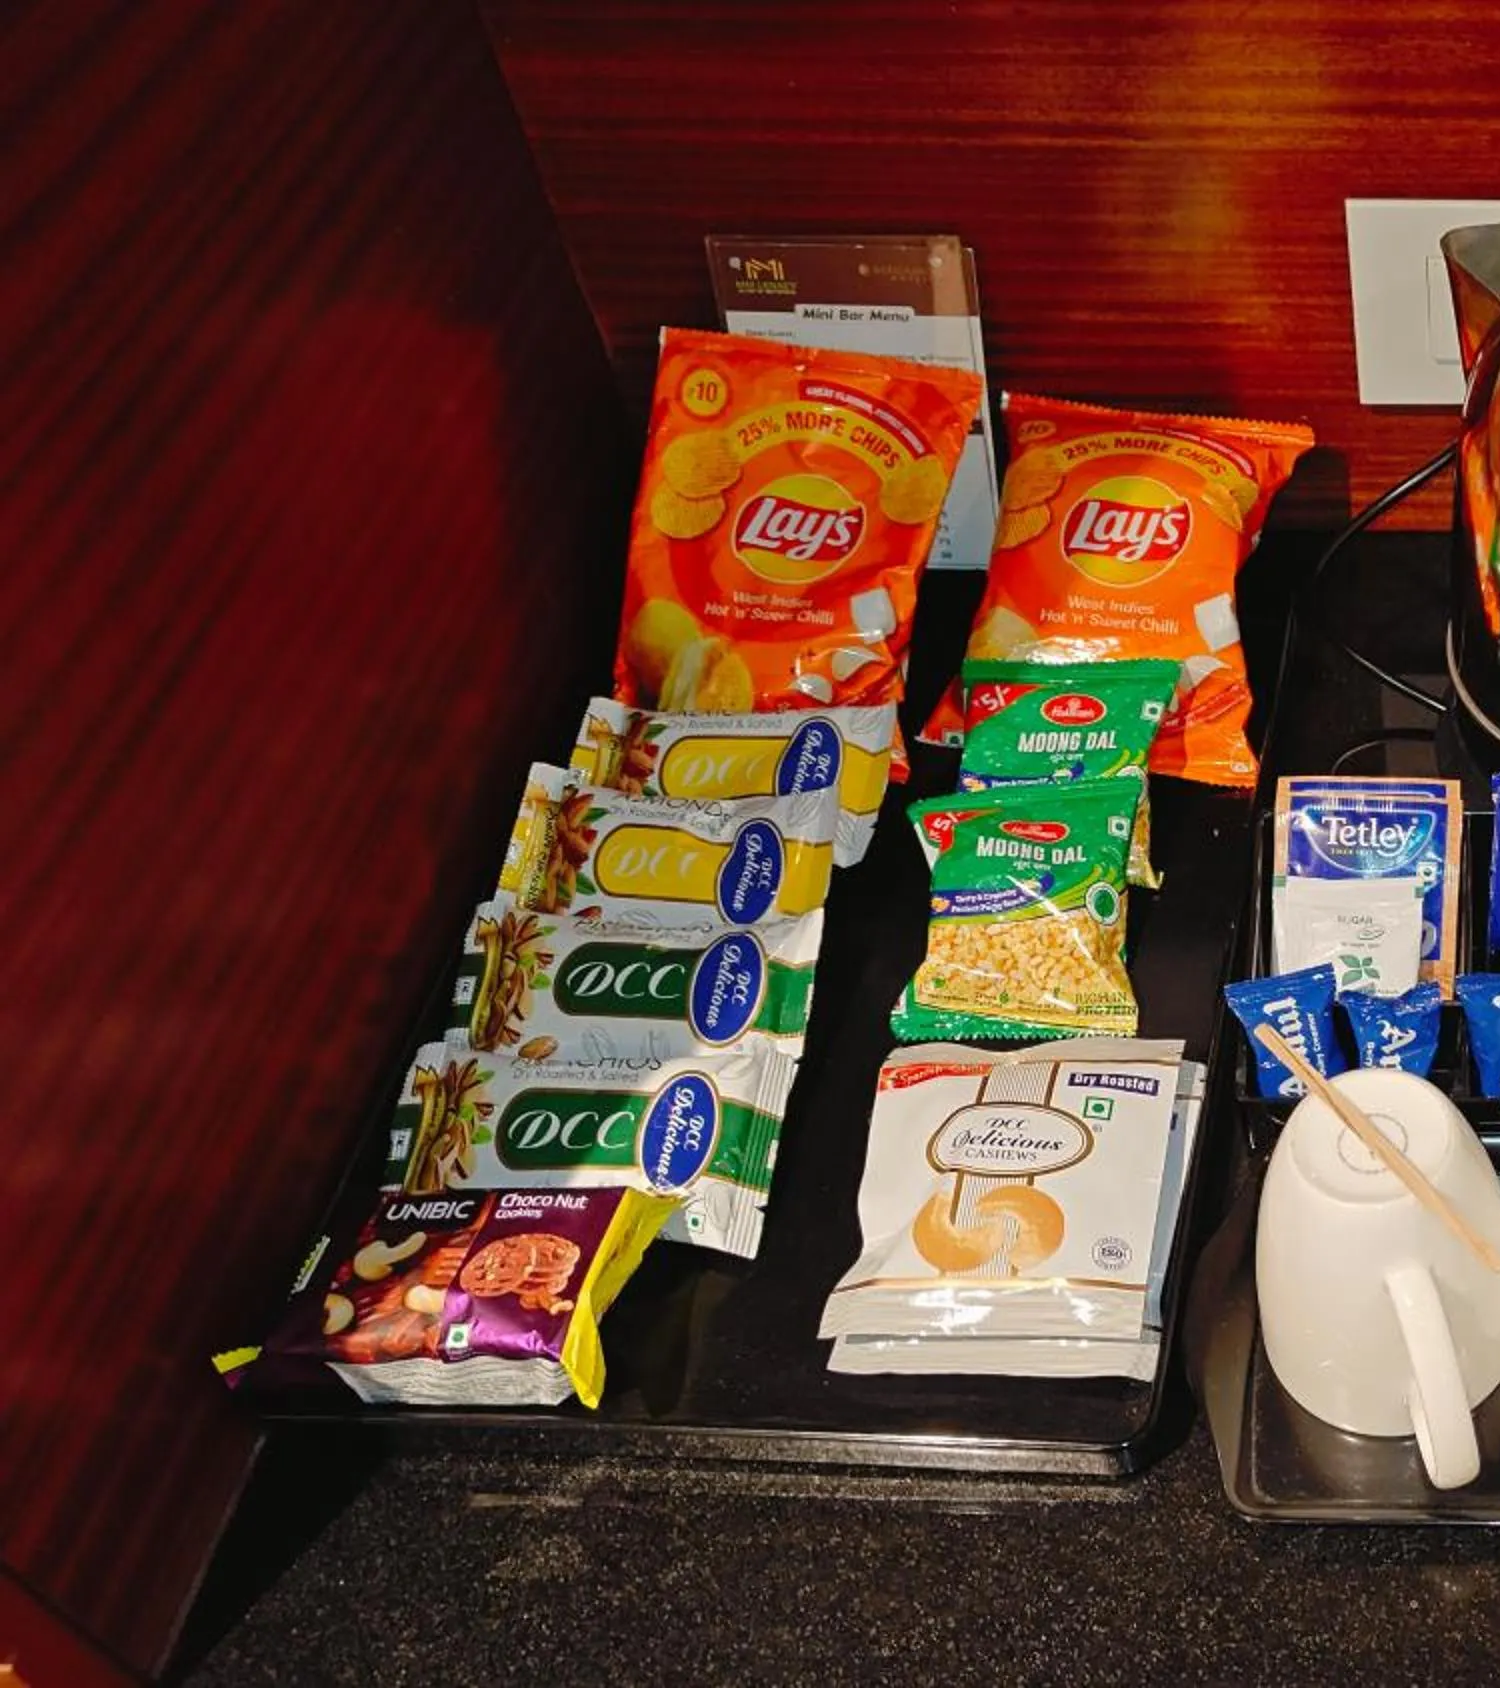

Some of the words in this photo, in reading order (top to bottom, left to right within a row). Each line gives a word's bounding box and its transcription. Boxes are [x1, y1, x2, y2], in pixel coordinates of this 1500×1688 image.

[802, 308, 833, 321] Mini
[839, 310, 864, 321] Bar
[869, 311, 910, 323] Menu
[736, 415, 781, 447] 25%
[784, 410, 846, 438] MORE
[848, 425, 901, 470] CHIPS
[1062, 438, 1108, 460] 25%
[1113, 436, 1170, 453] MORE
[1175, 446, 1227, 476] CHIPS
[740, 497, 859, 560] Lay's
[1067, 500, 1186, 563] Lay's
[703, 601, 729, 616] Hot
[796, 609, 834, 627] Chilli
[1068, 595, 1104, 611] West
[1108, 599, 1155, 615] Indies
[1039, 608, 1067, 623] Hot
[1089, 612, 1137, 630] Sweet
[1139, 617, 1180, 636] Chilli
[1018, 731, 1082, 753] MOONG
[1085, 730, 1118, 751] DAL
[976, 835, 1045, 862] MOONG
[1052, 845, 1087, 865] DAL
[1321, 815, 1417, 857] Tetley
[566, 960, 686, 999] DCC
[705, 943, 742, 1030] Delicious
[731, 970, 752, 1007] DCC
[1074, 1074, 1097, 1087] Dry
[1100, 1074, 1154, 1093] Roasted
[507, 1109, 636, 1149] DCC
[655, 1086, 696, 1179] Delicious
[682, 1114, 705, 1152] DCC
[985, 1115, 1031, 1131] DCC
[951, 1128, 1064, 1153] Delicious
[964, 1148, 1038, 1162] CASHEWS
[386, 1200, 476, 1221] UNIBIC
[500, 1193, 554, 1209] Choco
[554, 1193, 589, 1210] Nut
